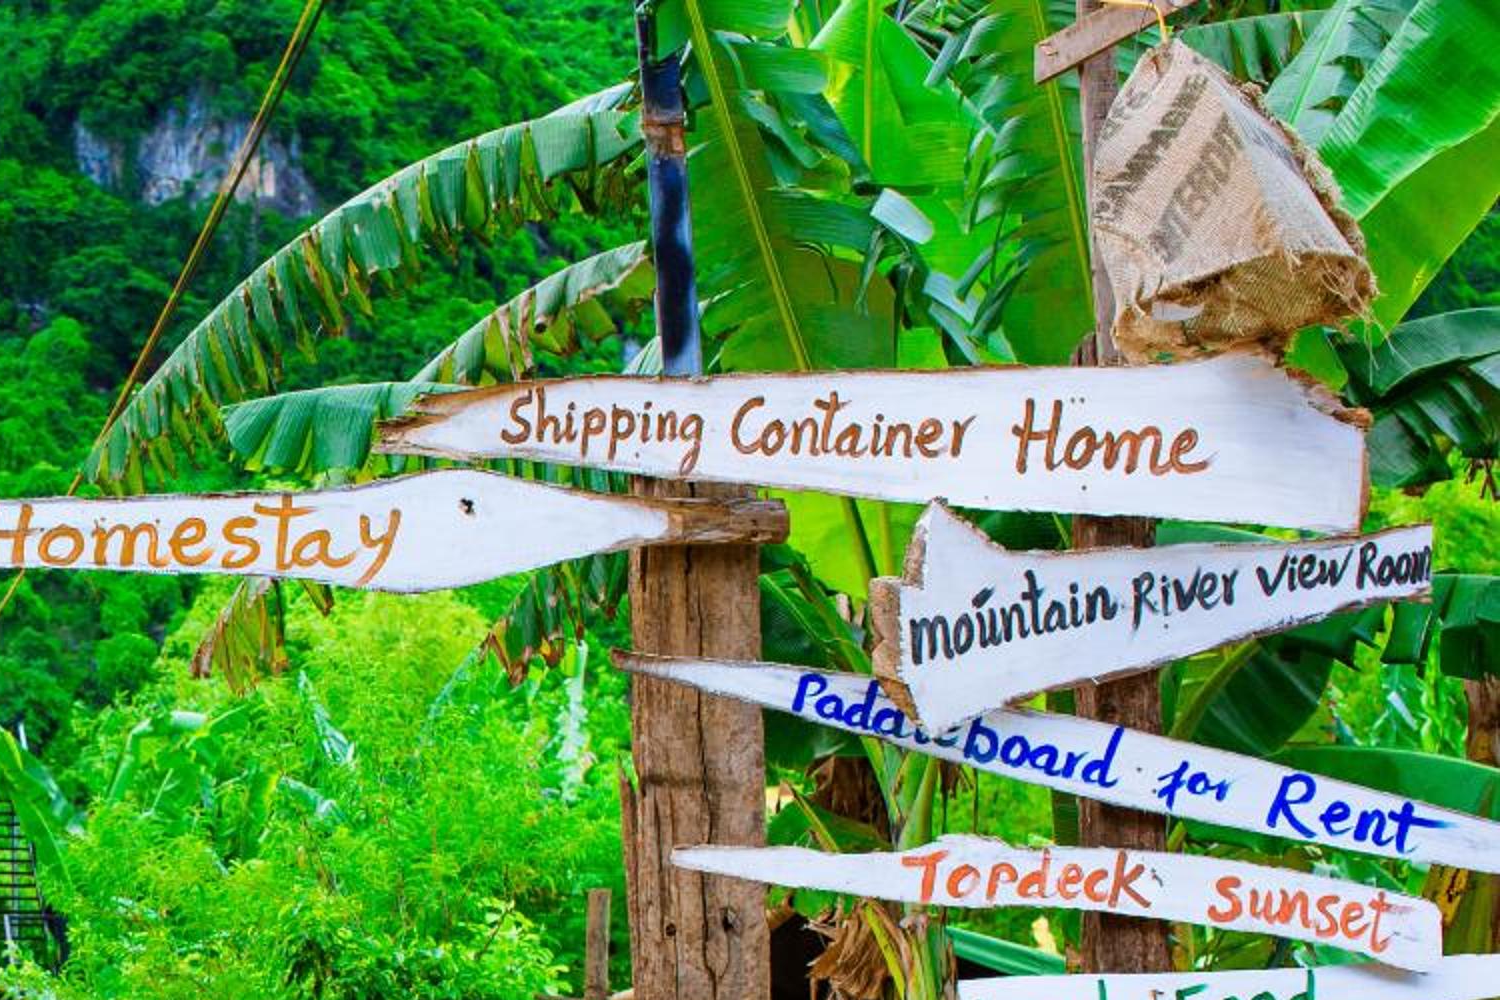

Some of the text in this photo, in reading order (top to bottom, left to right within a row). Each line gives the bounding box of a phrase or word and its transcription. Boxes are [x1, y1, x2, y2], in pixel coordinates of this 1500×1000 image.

[501, 388, 1218, 476] Shipping Container Home
[1132, 566, 1239, 628] River
[1356, 541, 1432, 590] Room
[791, 672, 1459, 854] Padaboard for Rent
